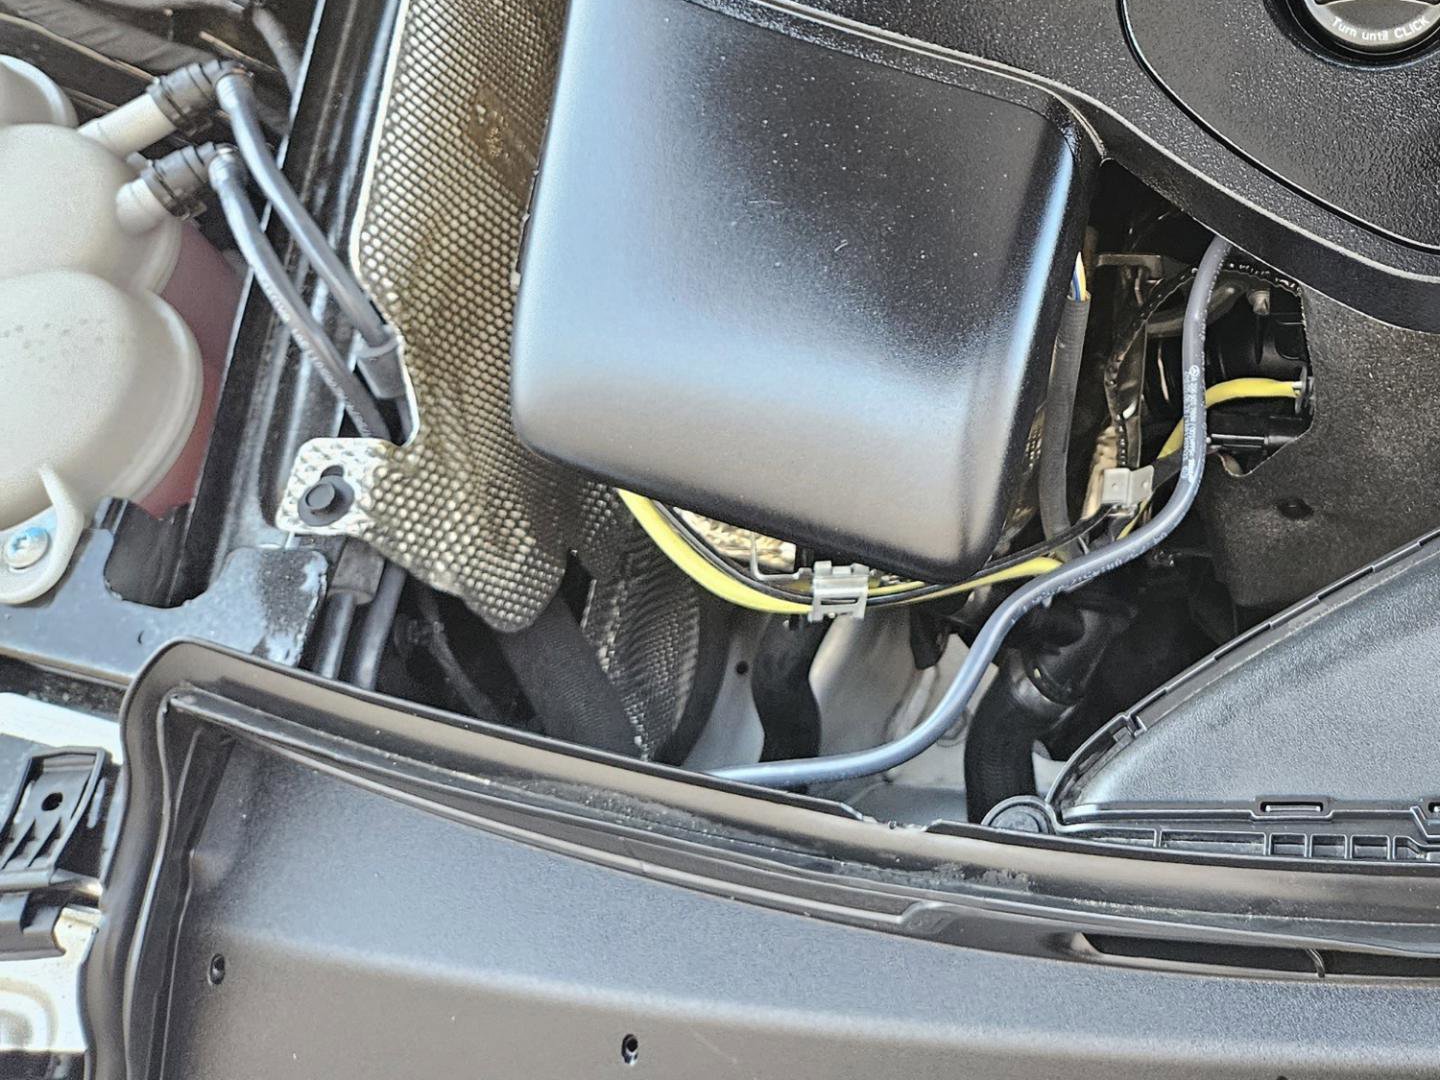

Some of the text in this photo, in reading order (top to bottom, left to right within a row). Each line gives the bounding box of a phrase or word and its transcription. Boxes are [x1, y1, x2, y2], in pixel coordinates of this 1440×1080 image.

[1331, 17, 1430, 42] Turn until CLICK
